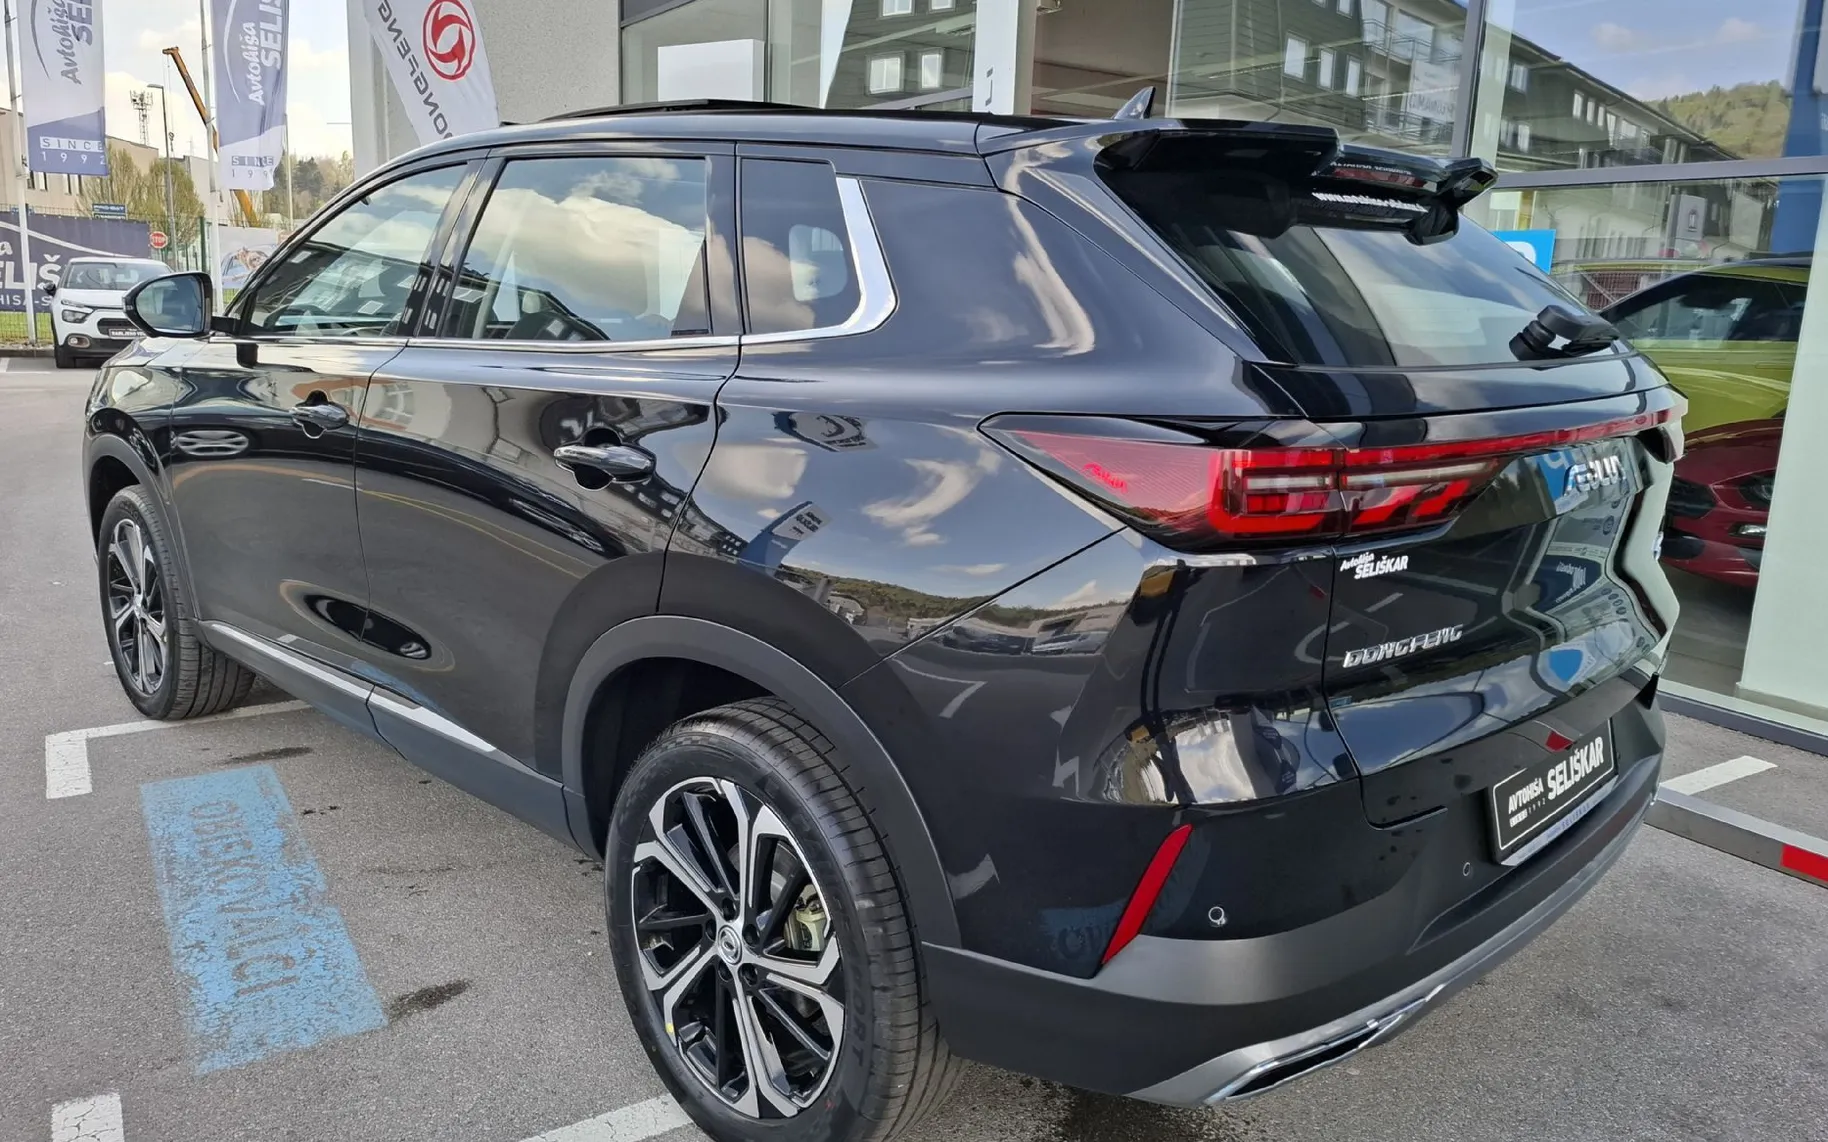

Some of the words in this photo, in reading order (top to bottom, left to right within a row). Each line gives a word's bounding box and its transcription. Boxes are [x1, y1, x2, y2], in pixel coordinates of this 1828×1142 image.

[67, 0, 93, 46] SE
[259, 0, 283, 70] SELI
[41, 151, 106, 165] 1992
[42, 138, 104, 151] SINCE
[151, 235, 168, 244] STOP
[1353, 555, 1409, 580] SELIŠKAR
[1342, 623, 1464, 669] DONGFENG
[1547, 736, 1604, 801] SELIŠKAR
